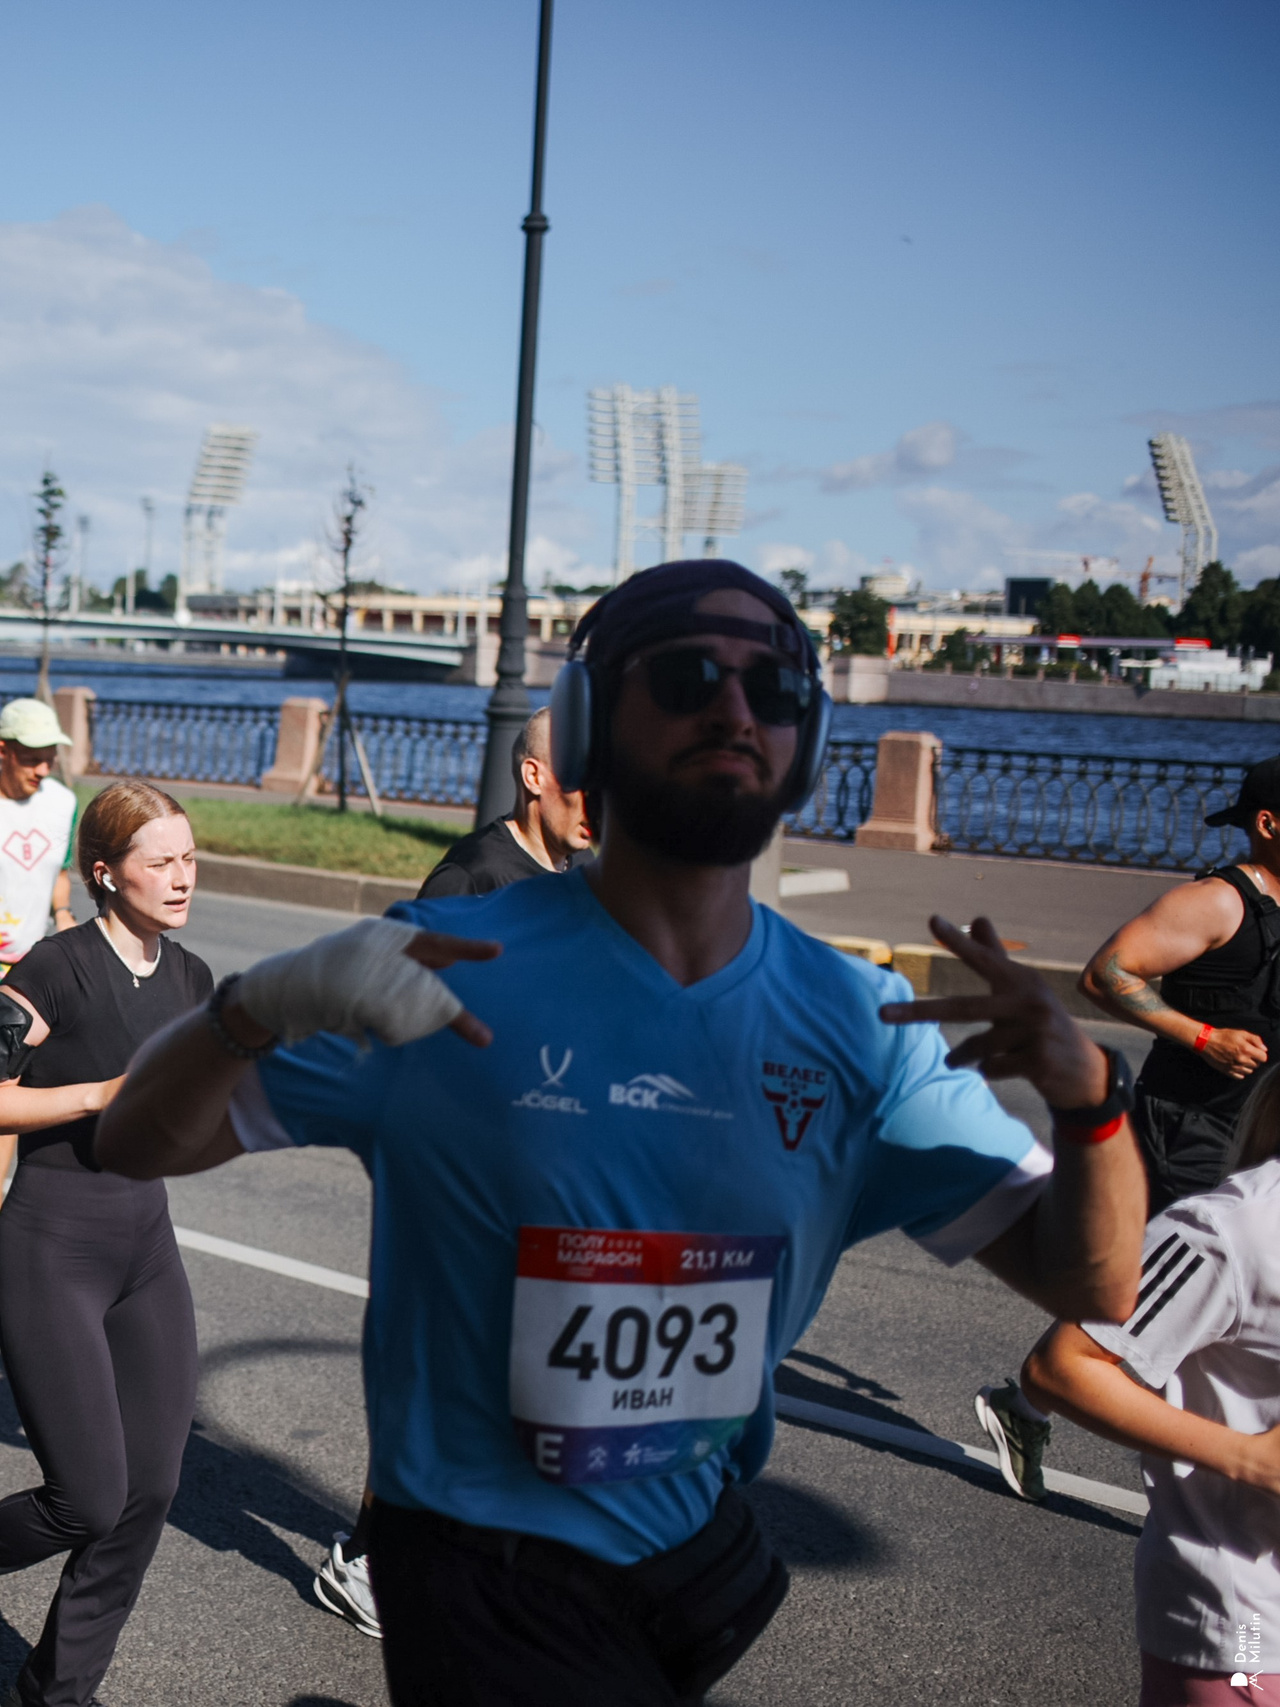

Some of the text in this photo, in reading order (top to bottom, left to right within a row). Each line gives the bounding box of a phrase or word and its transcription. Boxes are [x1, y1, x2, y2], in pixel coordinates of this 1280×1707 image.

[608, 1082, 660, 1111] ВСК
[557, 1232, 607, 1249] ПОЛУ
[556, 1250, 644, 1267] МАРАФОН
[680, 1250, 755, 1271] 21,1 КМ
[547, 1302, 738, 1382] 4093
[612, 1388, 674, 1411] ИВАН
[535, 1432, 564, 1474] E
